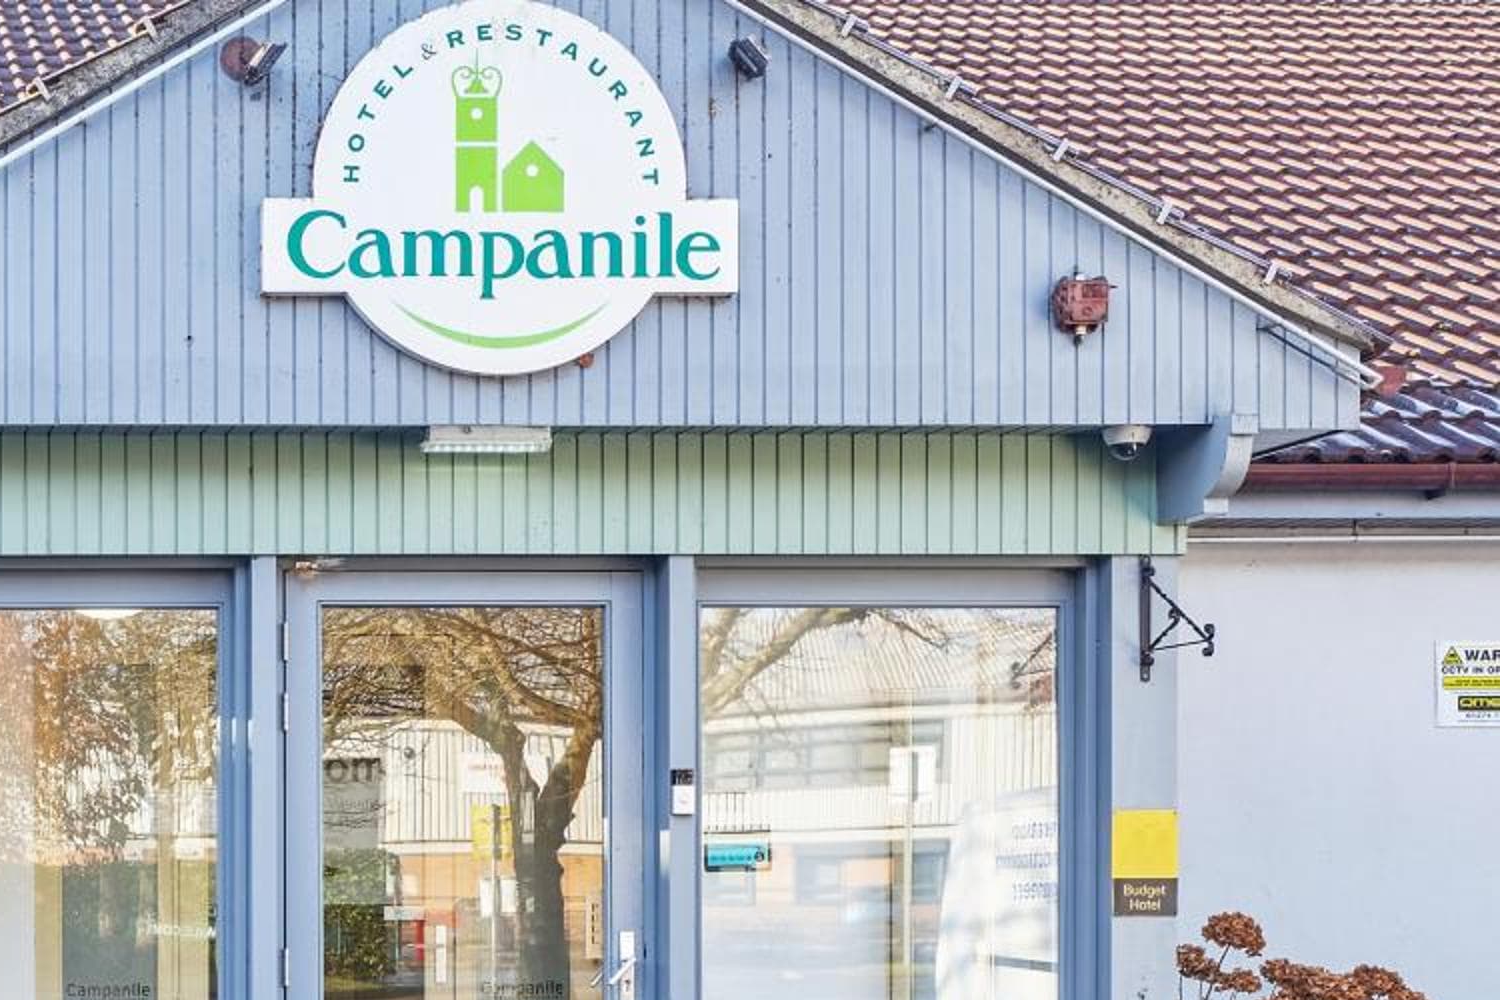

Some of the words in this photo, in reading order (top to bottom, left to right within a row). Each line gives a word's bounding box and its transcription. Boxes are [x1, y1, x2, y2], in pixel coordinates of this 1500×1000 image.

[343, 63, 412, 182] HOTEL
[421, 43, 436, 61] &
[445, 23, 660, 186] RESTAURANT
[287, 209, 721, 299] Campanile
[1441, 665, 1469, 674] CCTV
[1123, 883, 1166, 898] Budget
[1129, 899, 1161, 911] Hotel
[66, 981, 151, 999] Campanile
